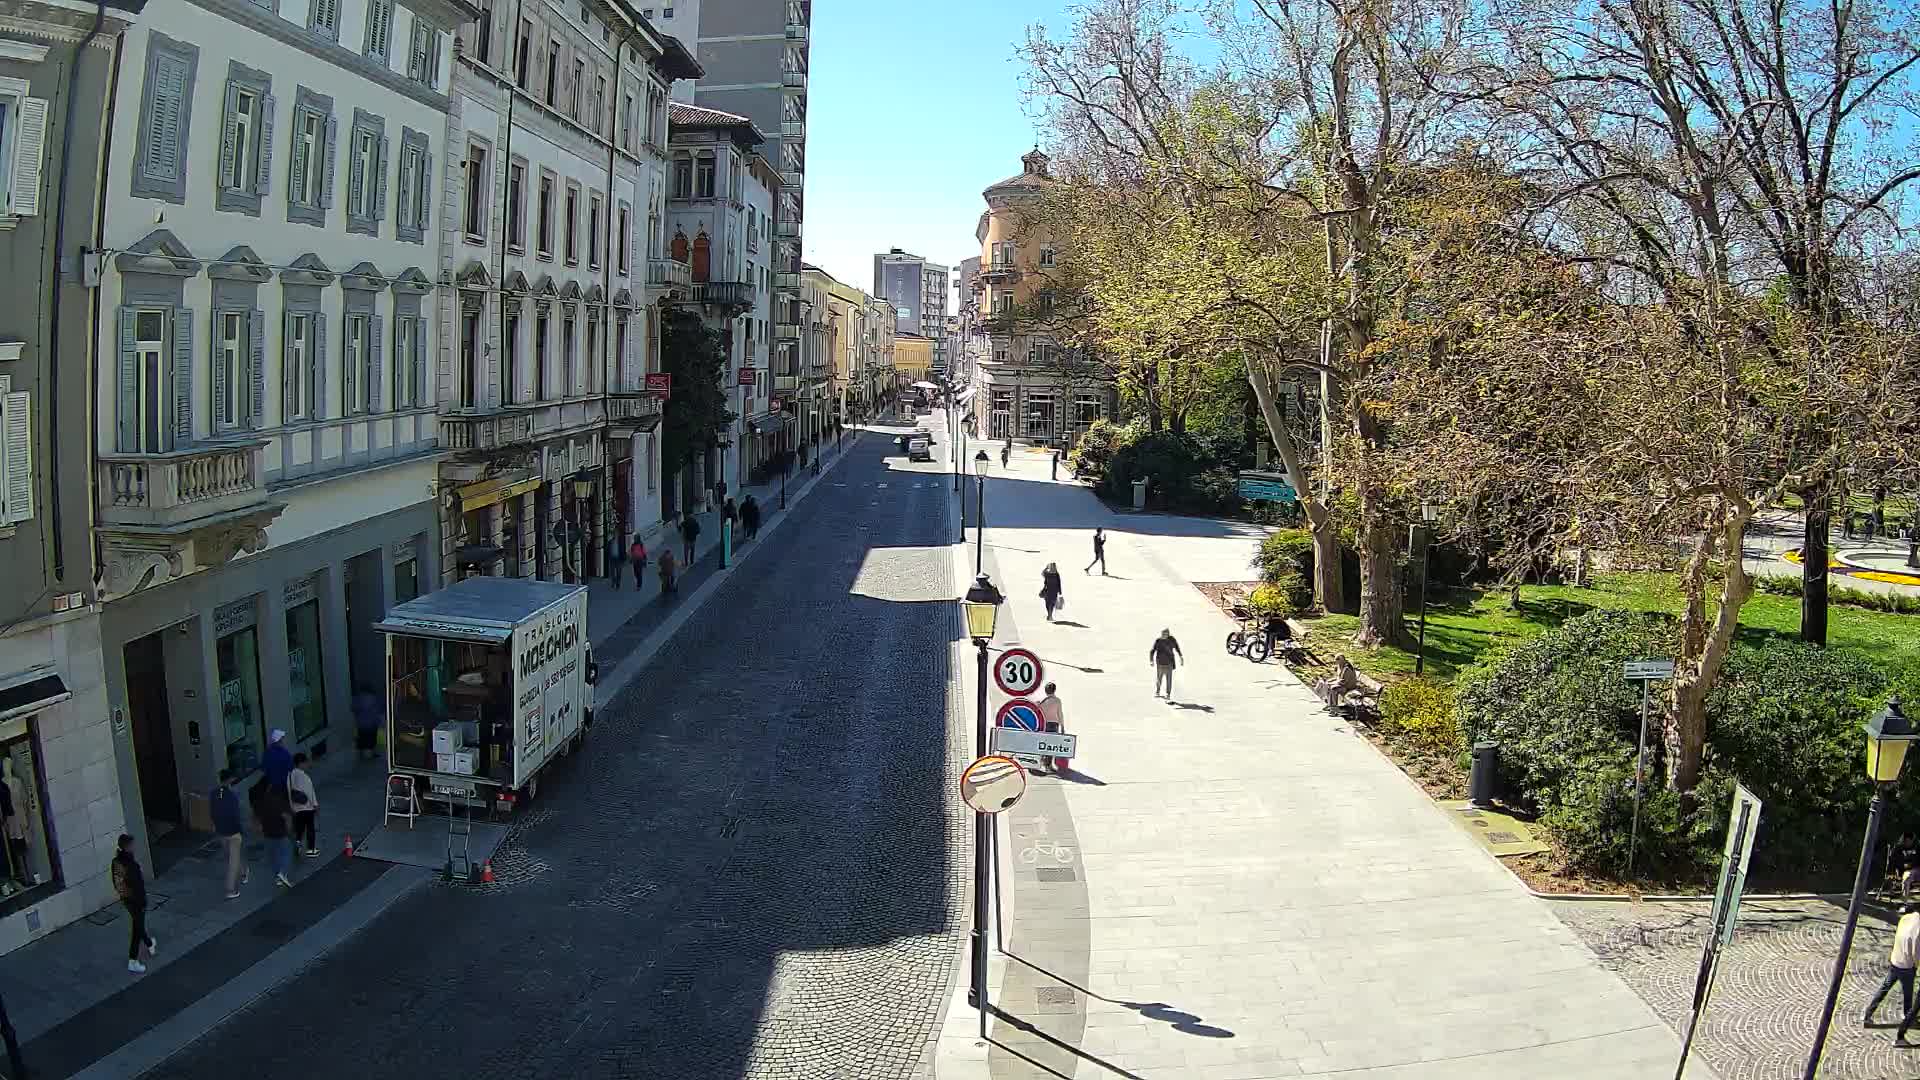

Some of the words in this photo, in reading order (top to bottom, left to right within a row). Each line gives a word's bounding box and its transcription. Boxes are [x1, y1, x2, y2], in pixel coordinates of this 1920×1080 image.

[520, 622, 579, 681] MOSCHION
[1005, 661, 1033, 684] 30
[1038, 742, 1070, 753] Dante
